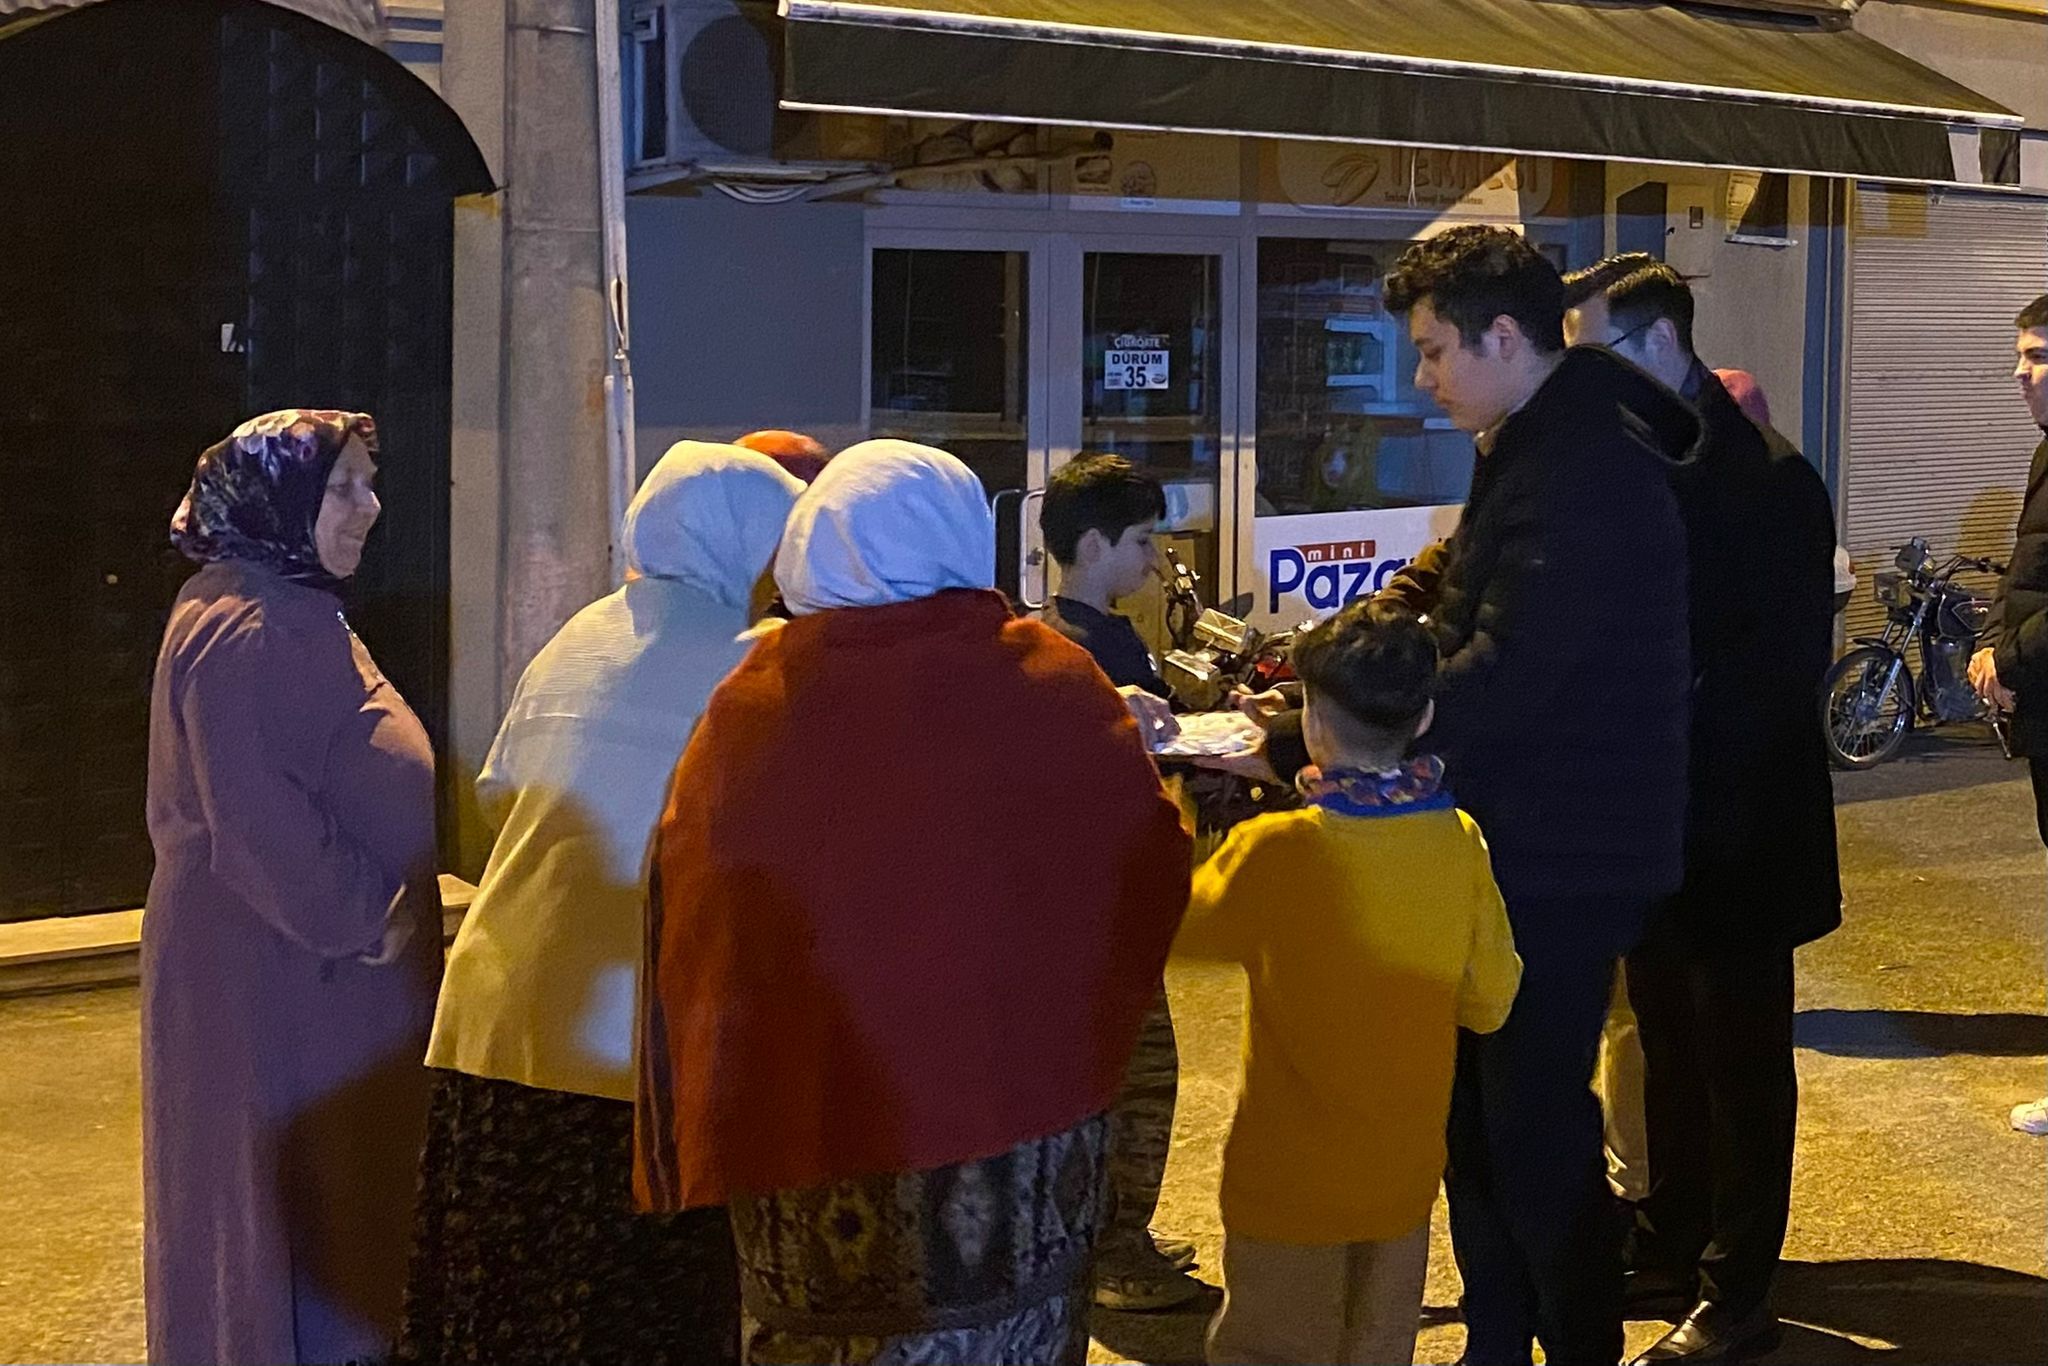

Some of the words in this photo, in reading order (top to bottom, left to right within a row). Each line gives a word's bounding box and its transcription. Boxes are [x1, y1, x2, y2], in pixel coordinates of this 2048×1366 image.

[1112, 351, 1163, 365] DÜRÜM
[1125, 366, 1147, 388] 35
[1307, 542, 1366, 562] mini
